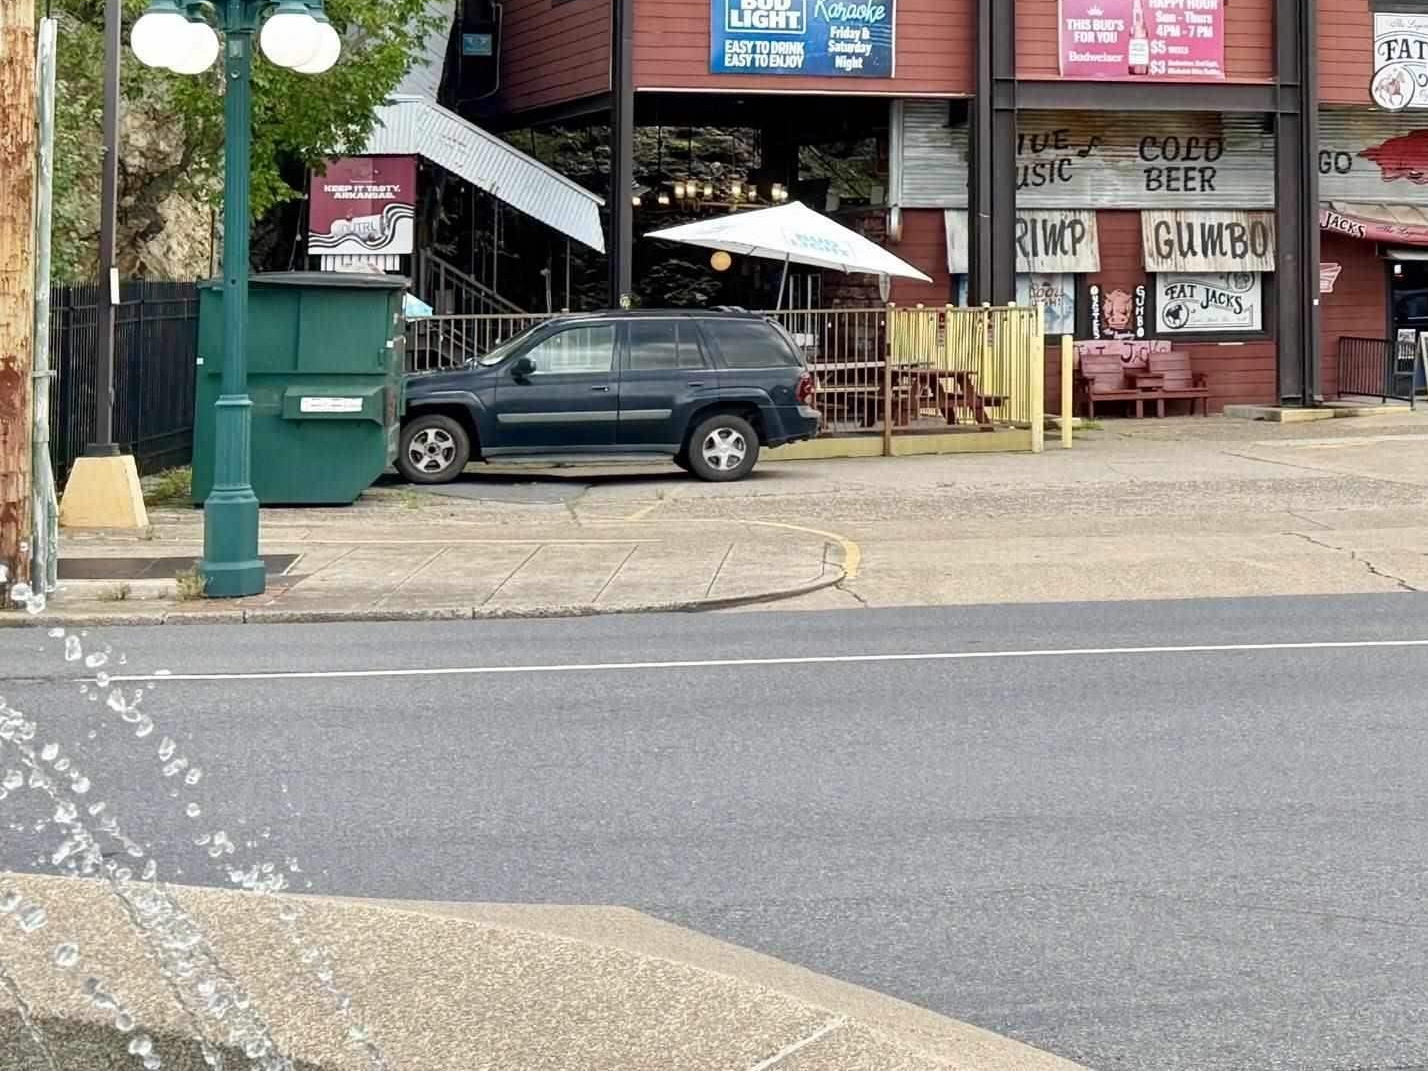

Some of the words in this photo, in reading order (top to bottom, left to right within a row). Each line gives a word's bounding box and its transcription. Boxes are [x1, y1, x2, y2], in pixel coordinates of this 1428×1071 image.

[730, 10, 800, 29] LIGHT
[1155, 10, 1177, 23] Sun
[1184, 11, 1213, 24] Thurs
[1066, 19, 1091, 30] THIS
[1093, 19, 1124, 31] BUD'S
[1156, 24, 1180, 37] 4PM
[1188, 25, 1196, 37] 7
[1197, 25, 1213, 37] PM
[830, 26, 859, 41] Friday
[860, 28, 870, 40] &
[1074, 31, 1095, 43] FOR
[1096, 31, 1118, 43] YOU
[725, 41, 754, 54] EASY
[755, 42, 769, 54] TO
[770, 42, 805, 55] DRINK
[828, 41, 872, 56] Saturday
[1150, 40, 1166, 55] $5
[725, 54, 753, 67] EASY
[754, 55, 769, 67] TO
[769, 55, 805, 68] ENJOY
[835, 57, 864, 71] Night
[1069, 50, 1124, 63] Budweiser
[1150, 60, 1166, 75] $3
[1017, 129, 1071, 155] IVE
[1139, 136, 1225, 162] COLD
[1319, 150, 1353, 175] GO
[1016, 158, 1073, 191] USIC
[1144, 167, 1216, 192] BEER
[324, 184, 352, 192] KEEP
[354, 184, 363, 192] IT
[1320, 212, 1366, 238] JACKS
[1016, 217, 1086, 258] RIMP
[1154, 219, 1269, 260] GUMBO
[1165, 284, 1197, 300] FAT
[1201, 288, 1243, 314] JACKS
[1136, 285, 1145, 338] GUMBO
